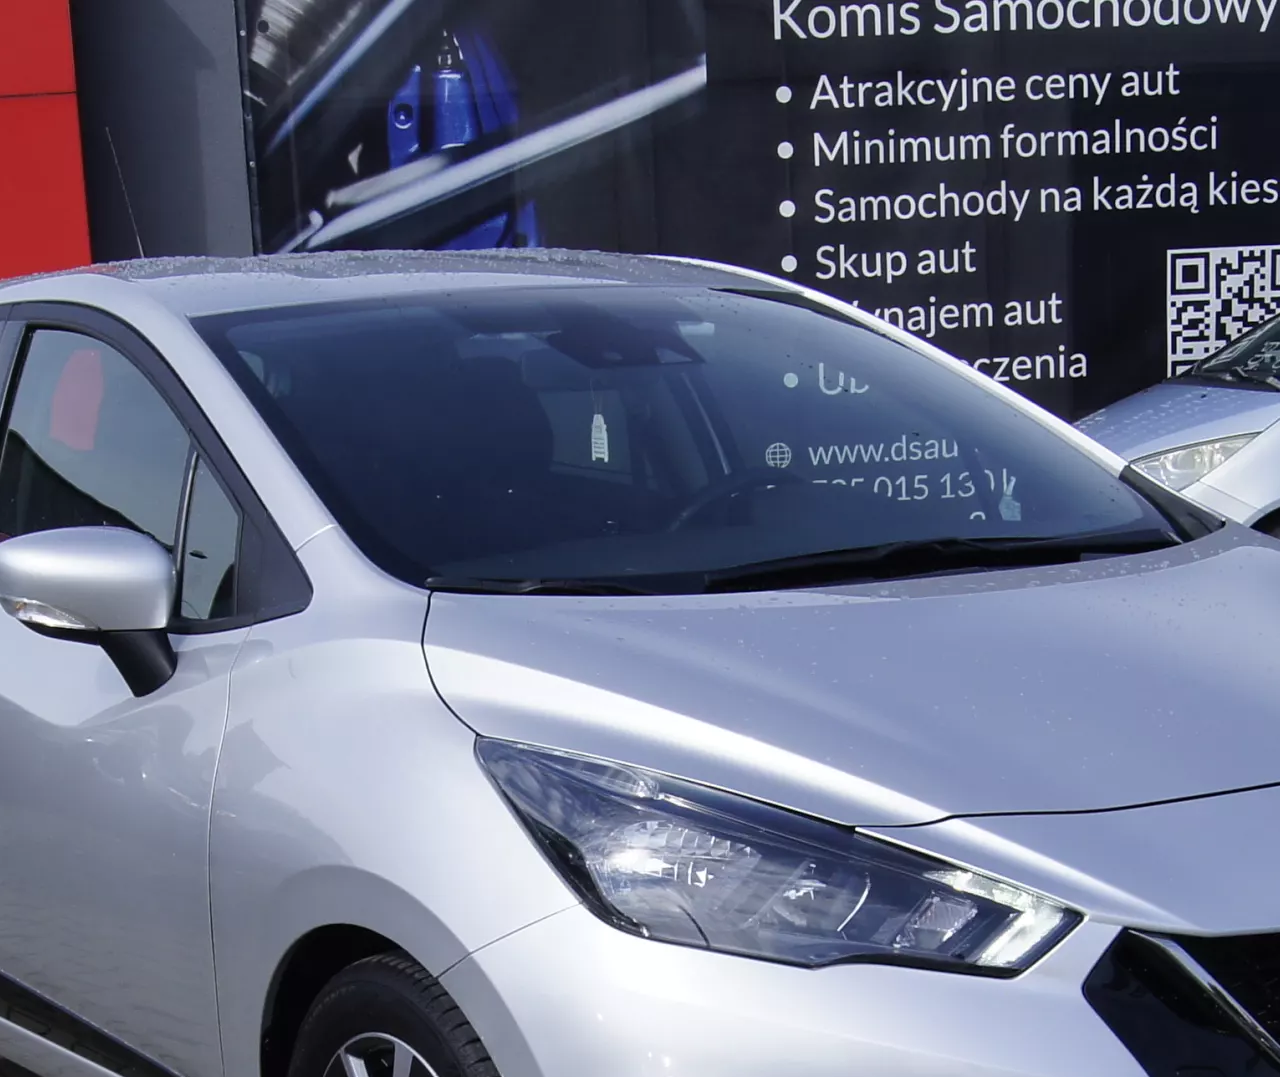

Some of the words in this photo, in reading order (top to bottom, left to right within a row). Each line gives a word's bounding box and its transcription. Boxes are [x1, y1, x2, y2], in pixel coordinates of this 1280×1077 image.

[772, 0, 920, 40] Komis
[933, 0, 1278, 35] Samochodowy
[809, 68, 1016, 112] Atrakcyjne
[1025, 72, 1112, 106] ceny
[1120, 62, 1180, 98] aut
[813, 128, 991, 167] Minimum
[1000, 115, 1218, 158] formalności
[814, 180, 1031, 224] Samochody
[1040, 186, 1082, 212] na
[1093, 173, 1199, 213] każdą
[815, 244, 908, 284] Skup
[917, 240, 976, 275] aut
[851, 296, 994, 338] najem
[1003, 292, 1063, 326] aut
